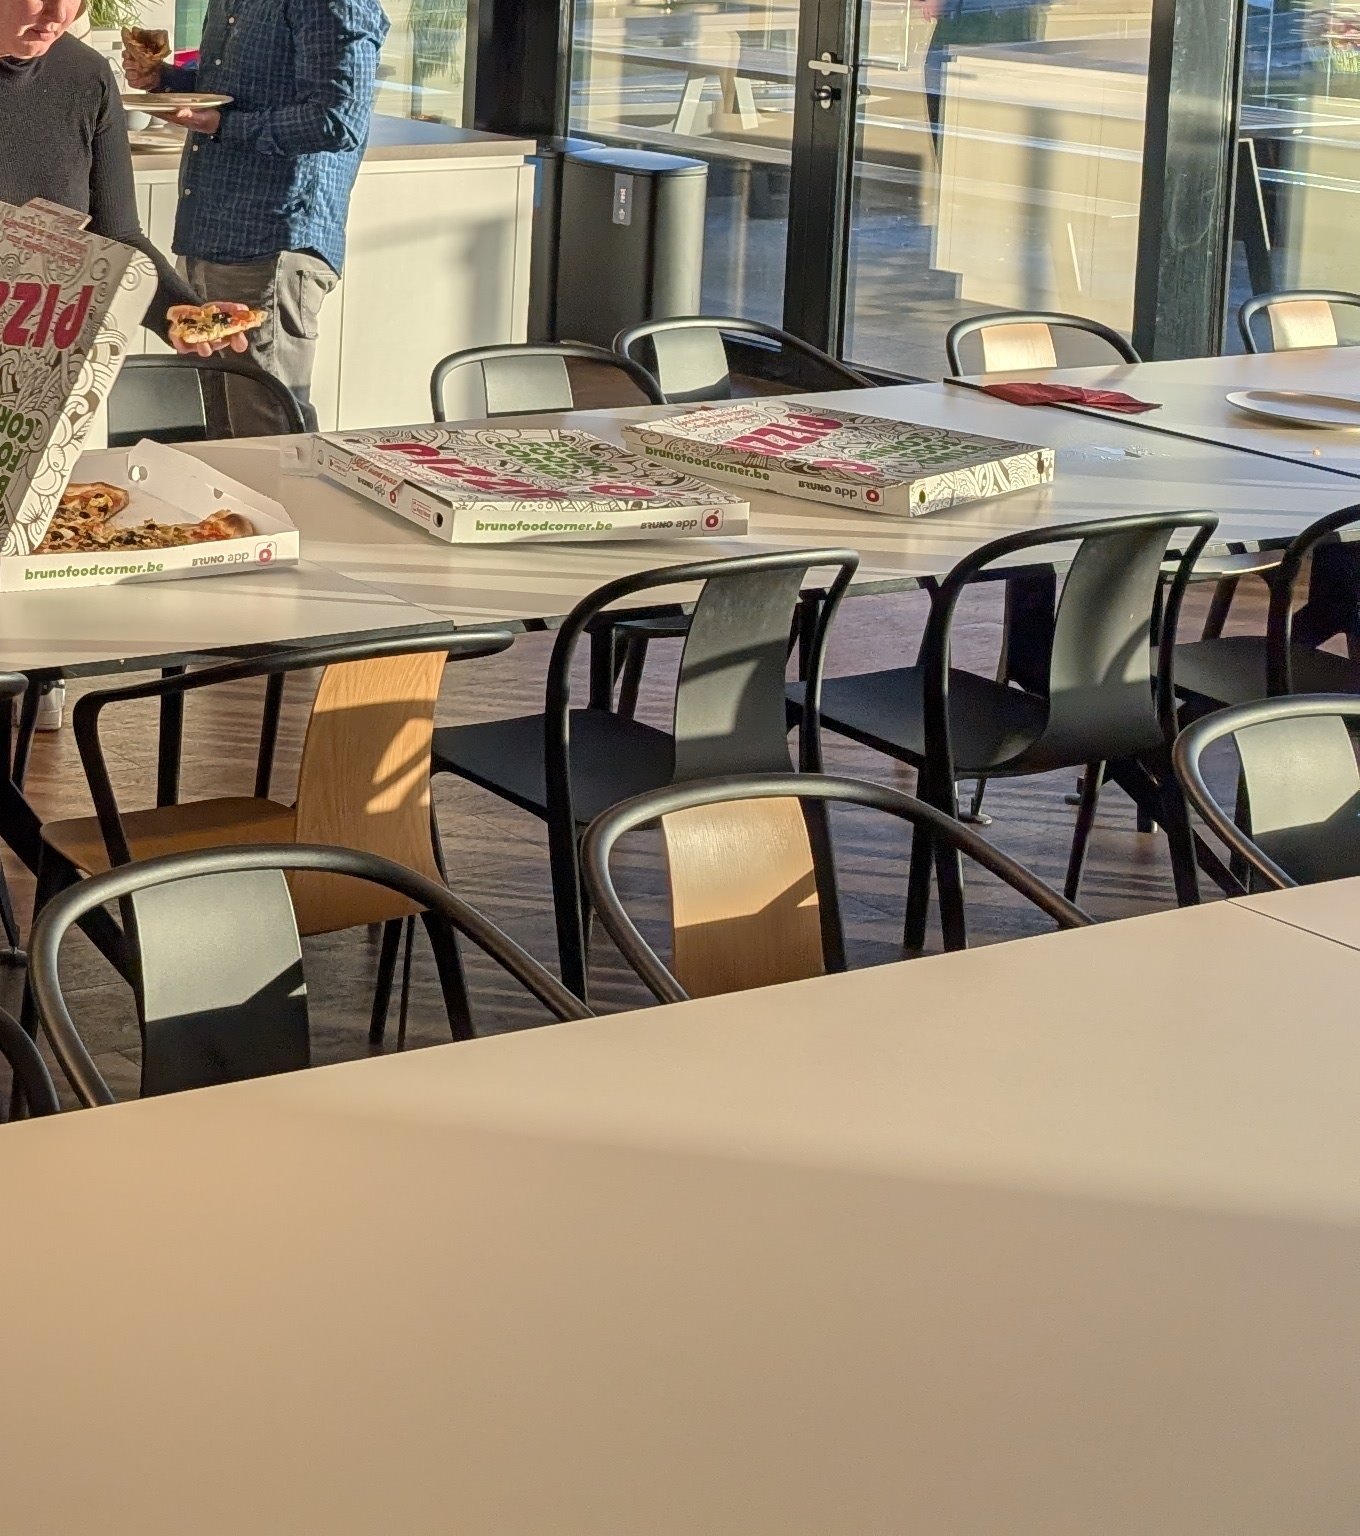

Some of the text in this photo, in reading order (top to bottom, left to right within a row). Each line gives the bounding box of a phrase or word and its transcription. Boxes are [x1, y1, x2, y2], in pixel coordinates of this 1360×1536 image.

[373, 443, 568, 499] PIZZA
[644, 446, 770, 481] brunofoodcorner.be
[798, 480, 858, 499] BRUNO app
[475, 520, 613, 532] brunofoodcorner.be
[640, 518, 697, 530] BRUNO app
[192, 552, 249, 566] BRUNO app
[24, 561, 164, 580] brunofoodcorner.be
